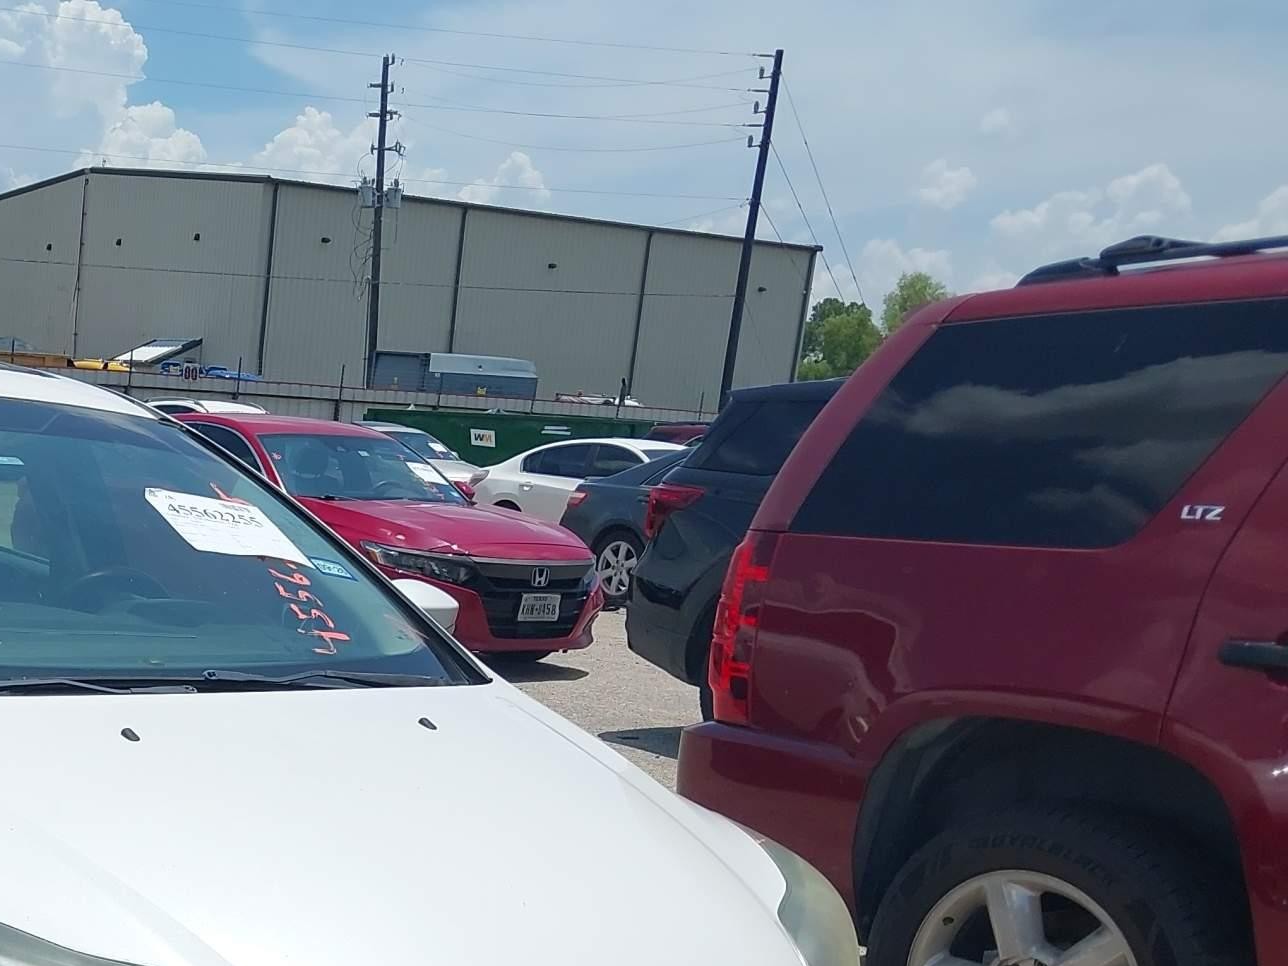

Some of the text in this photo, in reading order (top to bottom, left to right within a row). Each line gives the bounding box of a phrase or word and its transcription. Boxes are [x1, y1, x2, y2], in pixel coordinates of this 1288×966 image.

[474, 432, 492, 443] WM
[167, 503, 263, 529] 45562255
[1180, 504, 1226, 521] LTZ
